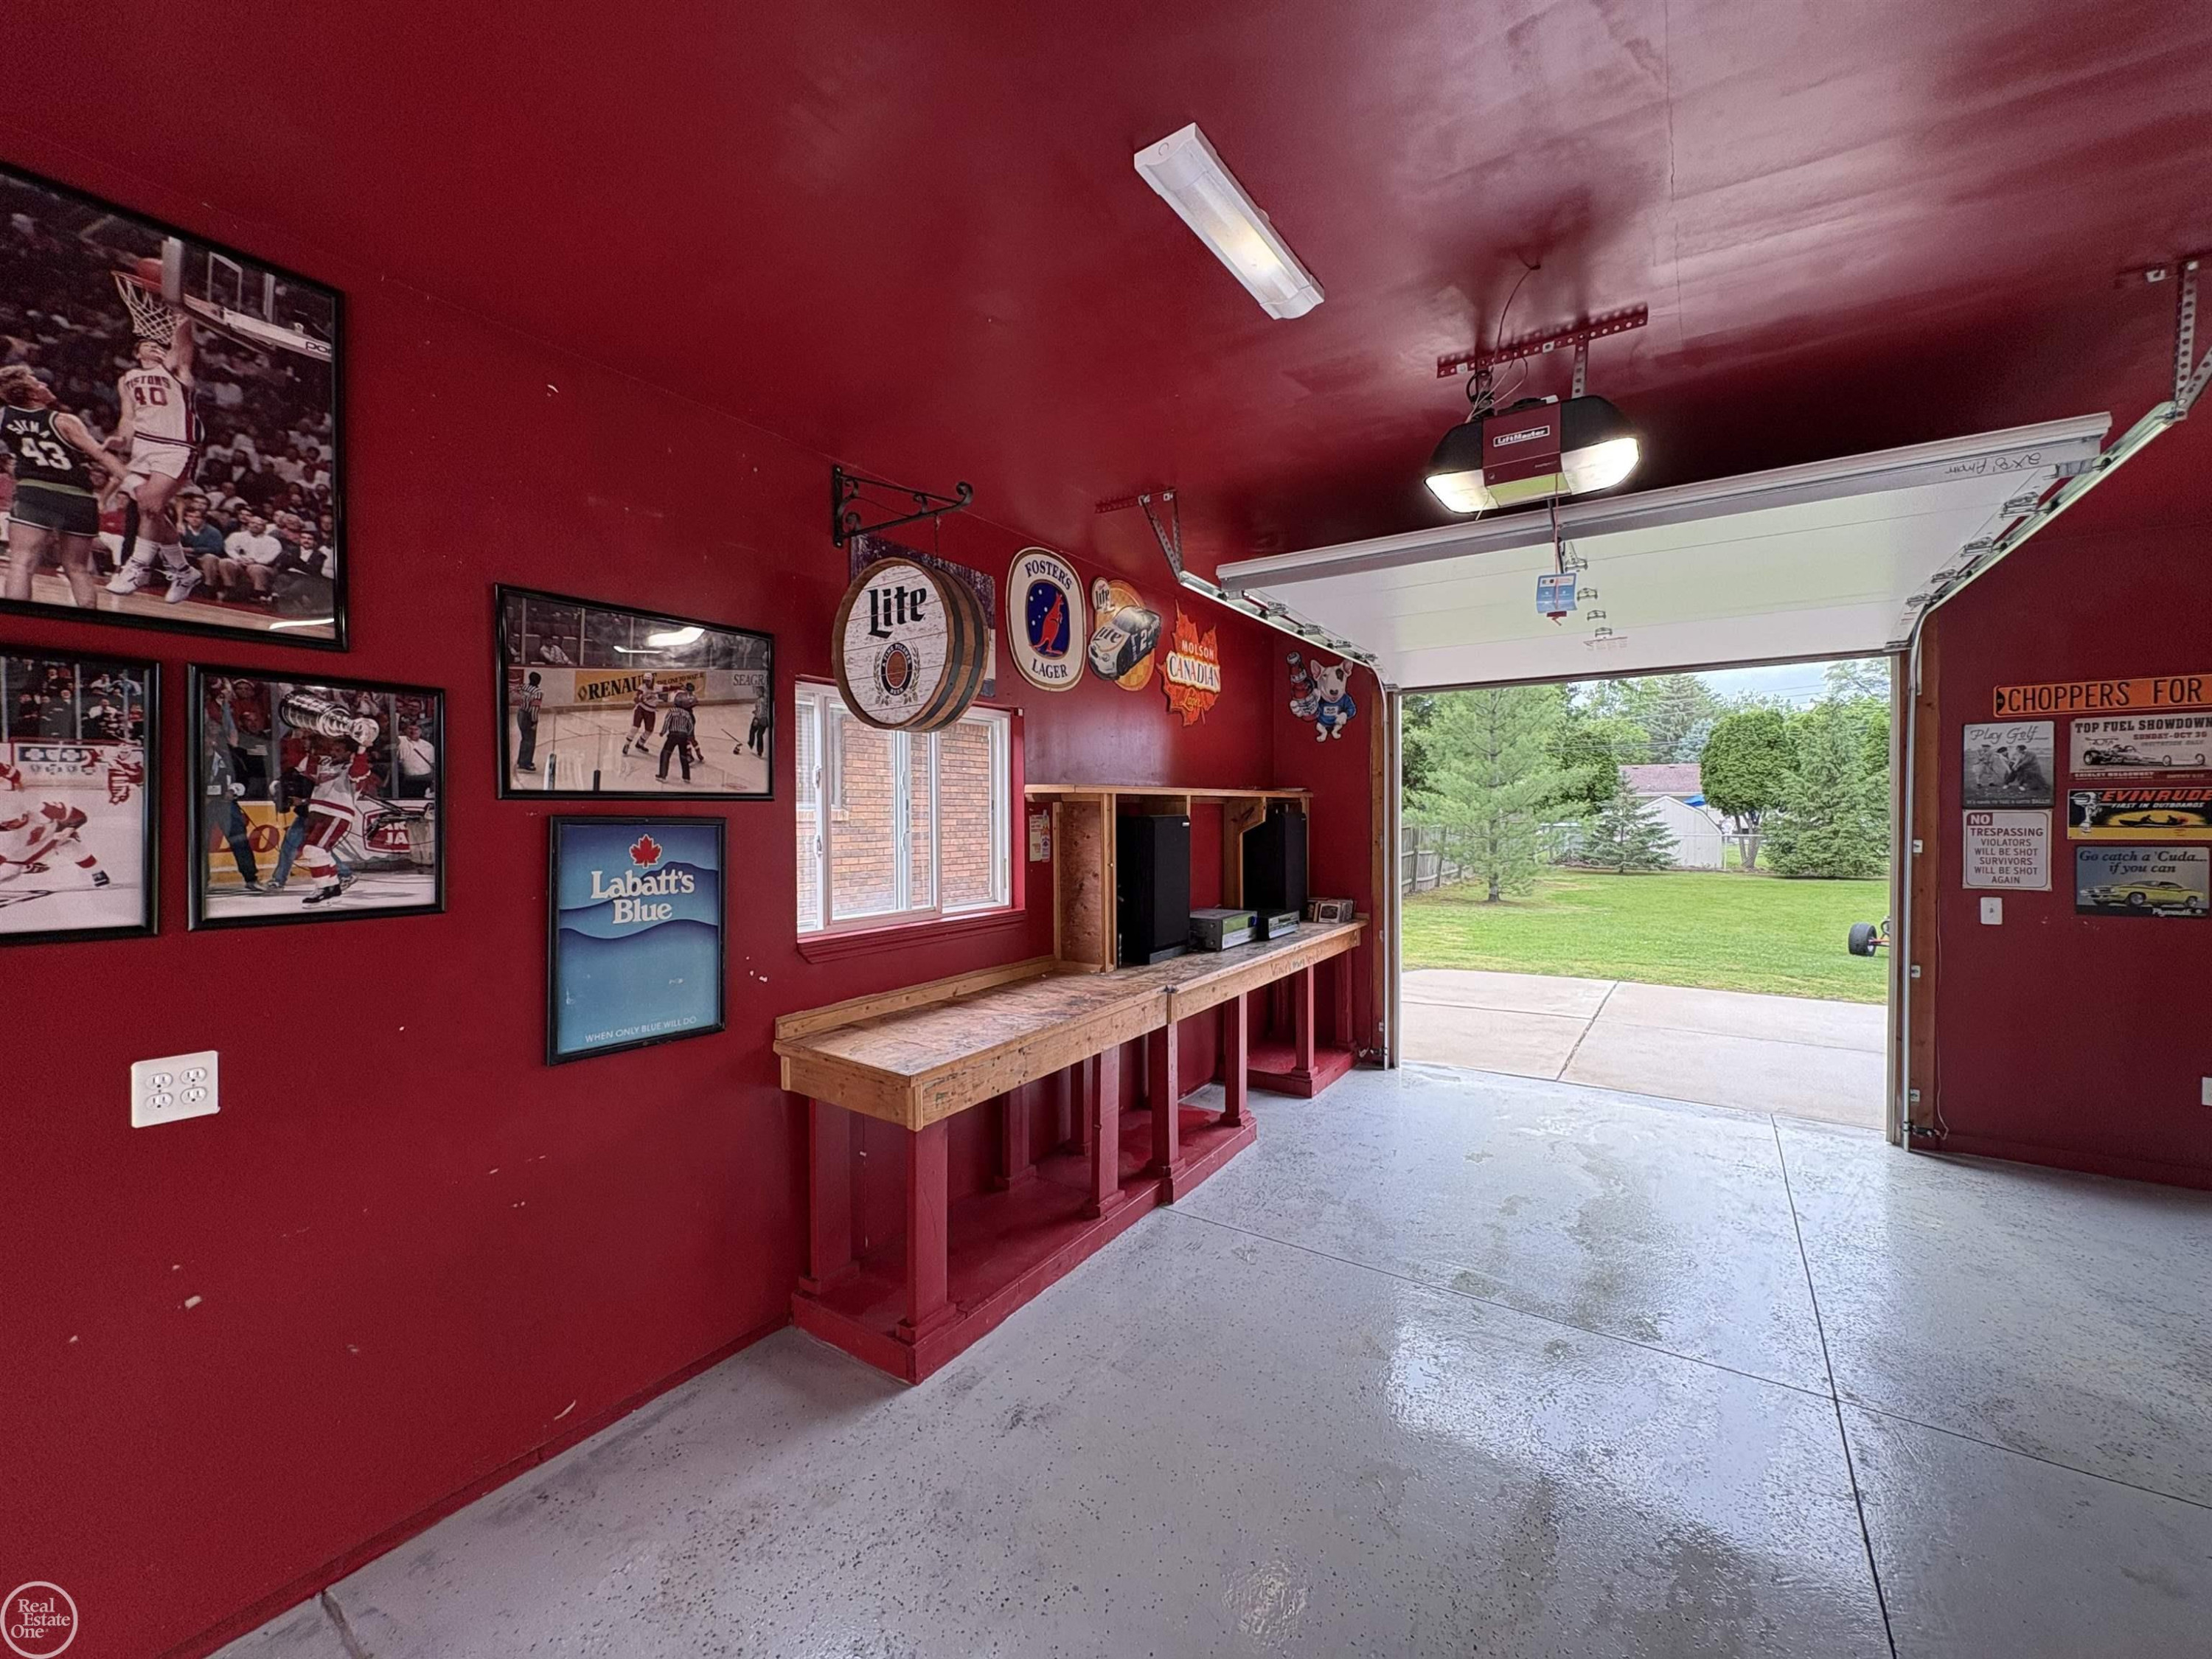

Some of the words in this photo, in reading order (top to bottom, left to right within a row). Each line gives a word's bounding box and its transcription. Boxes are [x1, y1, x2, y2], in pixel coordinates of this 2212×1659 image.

[133, 387, 168, 406] 40
[1498, 430, 1545, 444] LiftMaster
[21, 437, 72, 470] 43
[1024, 560, 1072, 591] FOSTER'S
[867, 586, 927, 639] Lite
[1092, 627, 1121, 643] Lite
[1181, 639, 1214, 661] MOLSON
[1032, 658, 1068, 678] LAGER
[1169, 655, 1220, 689] CANADIAN
[2008, 681, 2130, 712] CHOPPERS
[2152, 678, 2203, 704] FOR
[2075, 722, 2100, 734] TOP
[2103, 720, 2135, 732] FUEL
[2138, 717, 2212, 731] SHOWDOWN
[1970, 727, 2003, 745] Play
[2006, 725, 2042, 745] Golf
[2102, 789, 2212, 801] EVINRUDE
[1970, 815, 1991, 825] NO
[1970, 828, 2044, 837] TRESPASSING
[1980, 838, 2032, 847] VIOLATORS
[1974, 848, 1996, 856] WILL
[1998, 848, 2011, 856] BE
[2013, 848, 2039, 856] SHOT
[2079, 850, 2098, 862] Go
[2102, 850, 2138, 862] catch
[2141, 853, 2151, 861] a
[1979, 856, 2034, 866] SURVIVORS
[2109, 861, 2121, 874] if
[2121, 864, 2147, 874] you
[2151, 864, 2177, 873] can
[1974, 866, 1996, 874] WILL
[1998, 866, 2011, 874] BE
[2013, 866, 2039, 875] SHOT
[591, 869, 695, 899] Labatt's
[1992, 876, 2020, 884] AGAIN
[613, 899, 672, 924] Blue
[2152, 908, 2192, 917] Plymouth
[585, 1030, 613, 1043] WHEN
[615, 1026, 640, 1037] ONLY
[641, 1022, 661, 1033] BLUE
[663, 1018, 681, 1029] WILL
[683, 1016, 697, 1025] DO
